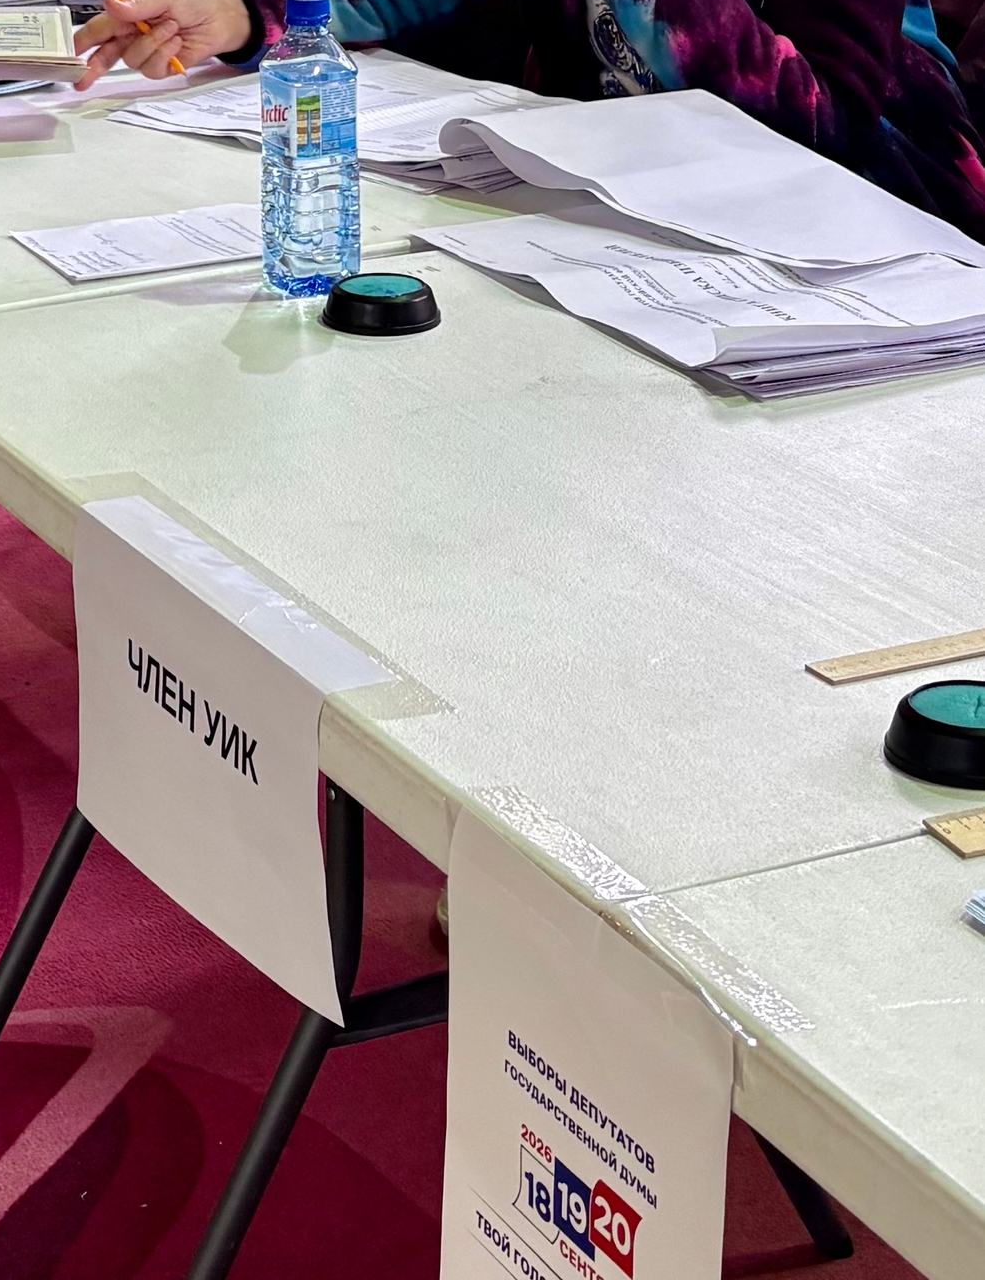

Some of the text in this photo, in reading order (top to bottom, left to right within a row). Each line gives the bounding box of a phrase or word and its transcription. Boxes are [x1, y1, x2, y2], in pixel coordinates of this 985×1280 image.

[127, 637, 259, 786] ЧЛЕН УИК
[503, 1058, 658, 1209] ГОСУДАРСТВЕННОЙ ДУМЫ
[507, 1029, 656, 1174] ВЫБОРЫ ДЕПУТАТОВ
[520, 1123, 553, 1164] 2026
[475, 1210, 547, 1280] ТВОЙ ГОЛ
[524, 1171, 631, 1256] 18 19 20
[559, 1239, 605, 1280] СЕНТ
